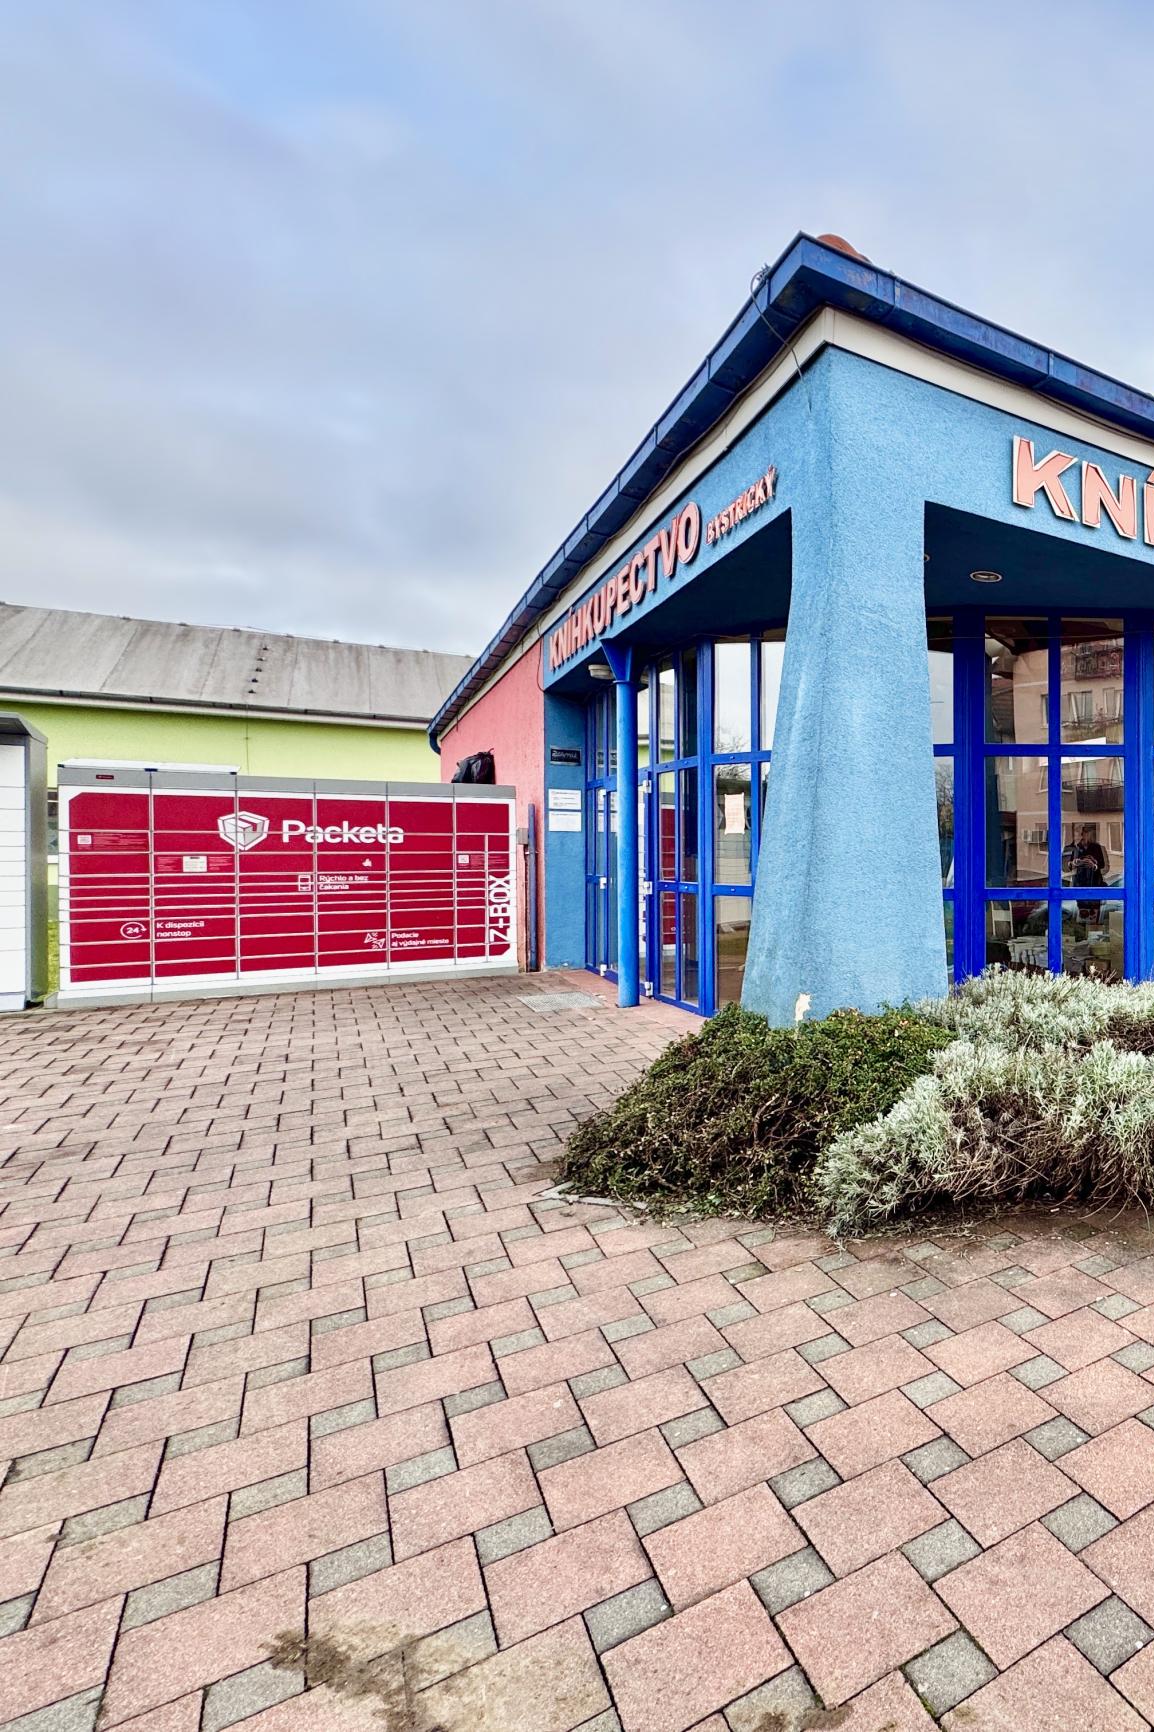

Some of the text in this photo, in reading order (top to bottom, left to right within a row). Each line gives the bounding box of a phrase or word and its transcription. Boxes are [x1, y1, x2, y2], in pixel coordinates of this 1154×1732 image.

[549, 464, 777, 671] KNÍHKUPECTVO BYSTRICKÝ
[281, 819, 405, 844] Packeta
[489, 874, 511, 942] Z-BOX
[156, 930, 192, 938] nonstop
